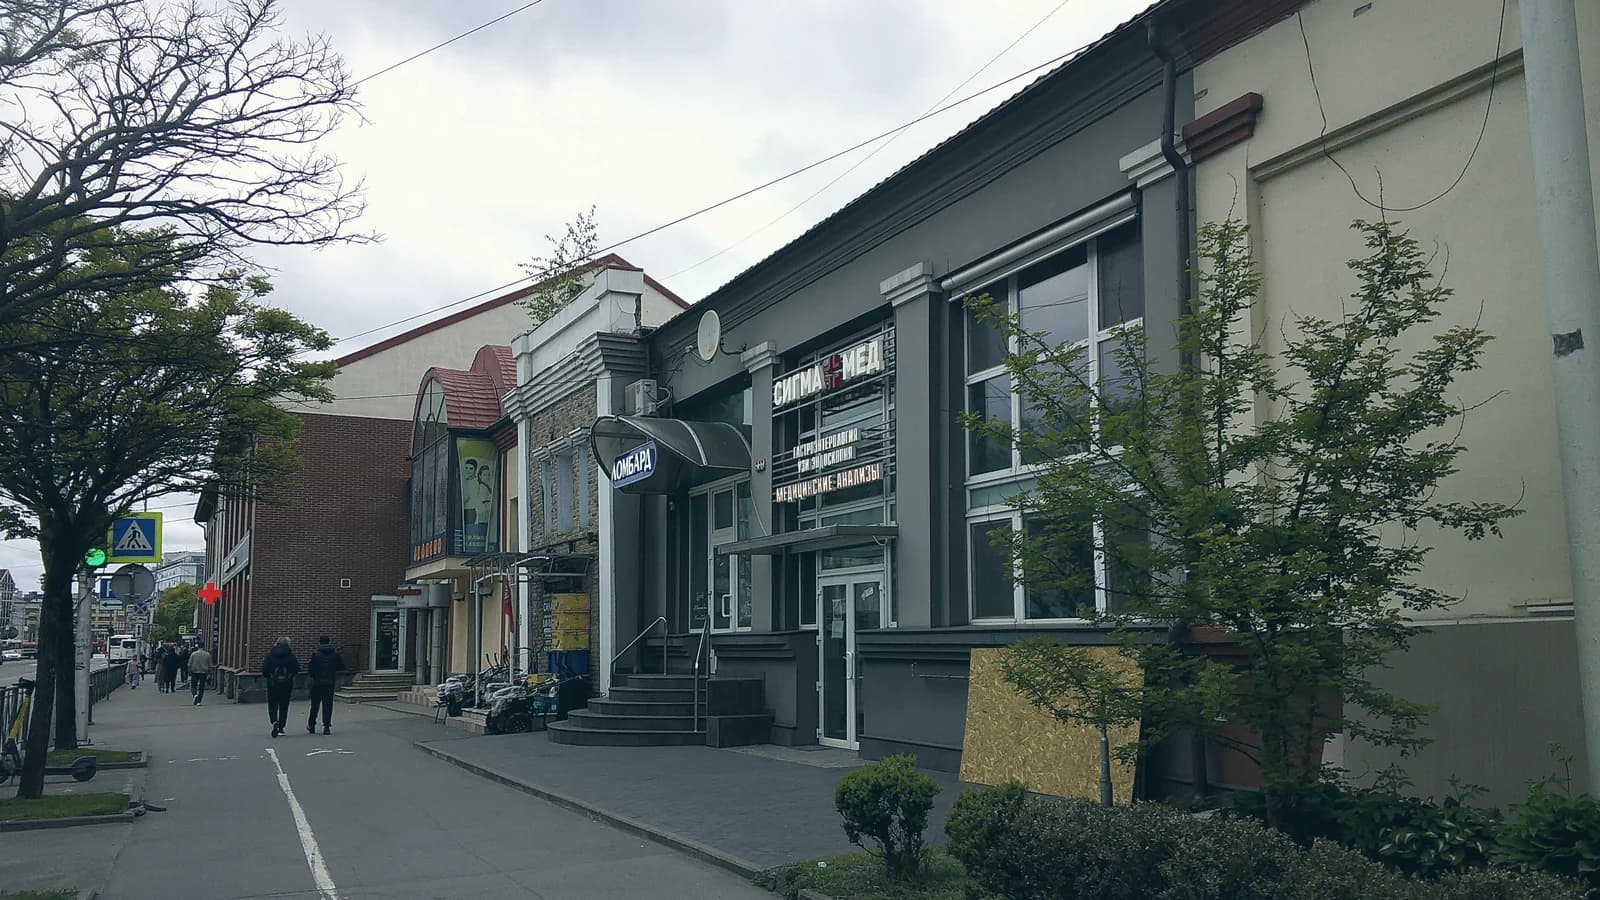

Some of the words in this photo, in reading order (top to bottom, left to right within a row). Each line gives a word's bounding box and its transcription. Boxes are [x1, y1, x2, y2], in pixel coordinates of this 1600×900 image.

[774, 364, 825, 406] СИГМА
[842, 339, 885, 381] МЕД
[611, 448, 652, 481] ЛОМБАРД
[776, 476, 833, 503] МЕДИЦИНСКИЕ
[836, 463, 881, 489] АНАЛИЗЫ
